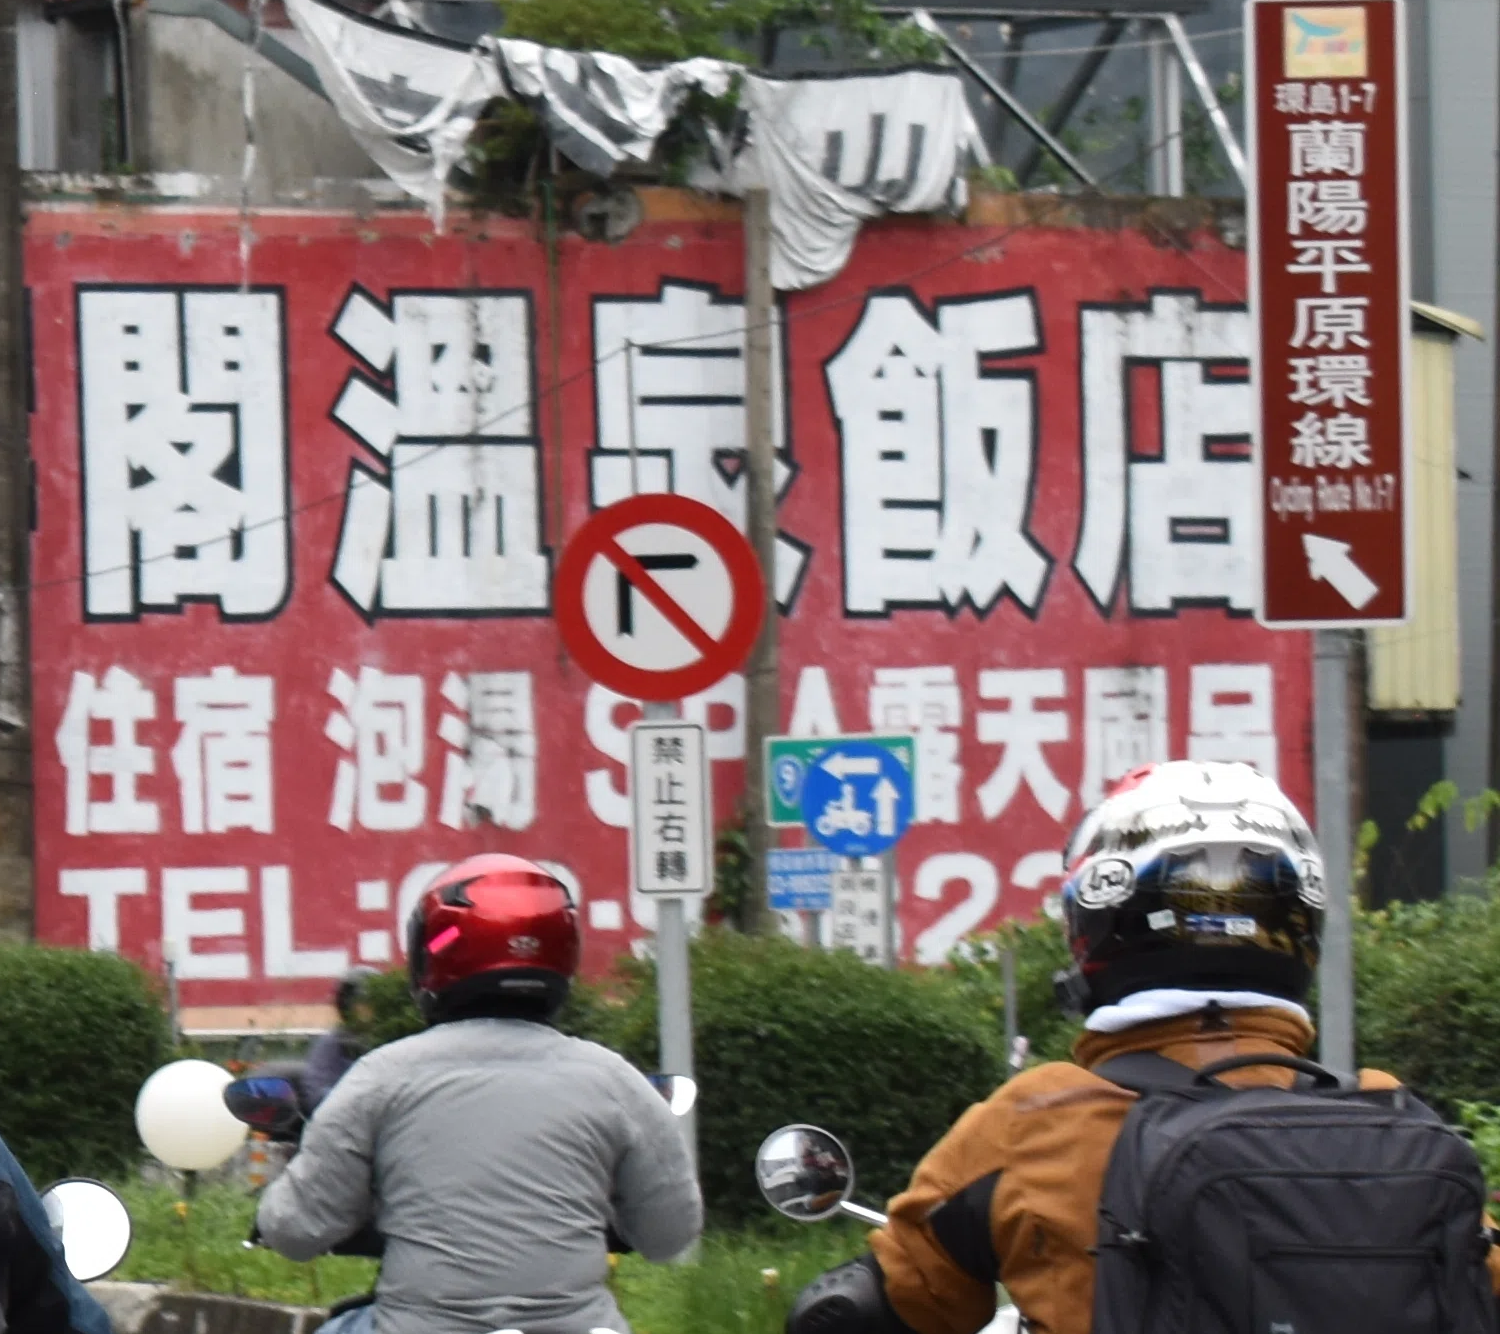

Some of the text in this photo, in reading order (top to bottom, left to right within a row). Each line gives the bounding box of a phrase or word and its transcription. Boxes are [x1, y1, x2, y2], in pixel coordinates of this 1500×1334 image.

[1274, 83, 1378, 115] 環島1-7
[1286, 120, 1372, 468] 蘭陽平原環線
[57, 667, 275, 835] 住宿
[327, 667, 536, 832] 泡湯
[652, 736, 688, 882] 禁止右轉
